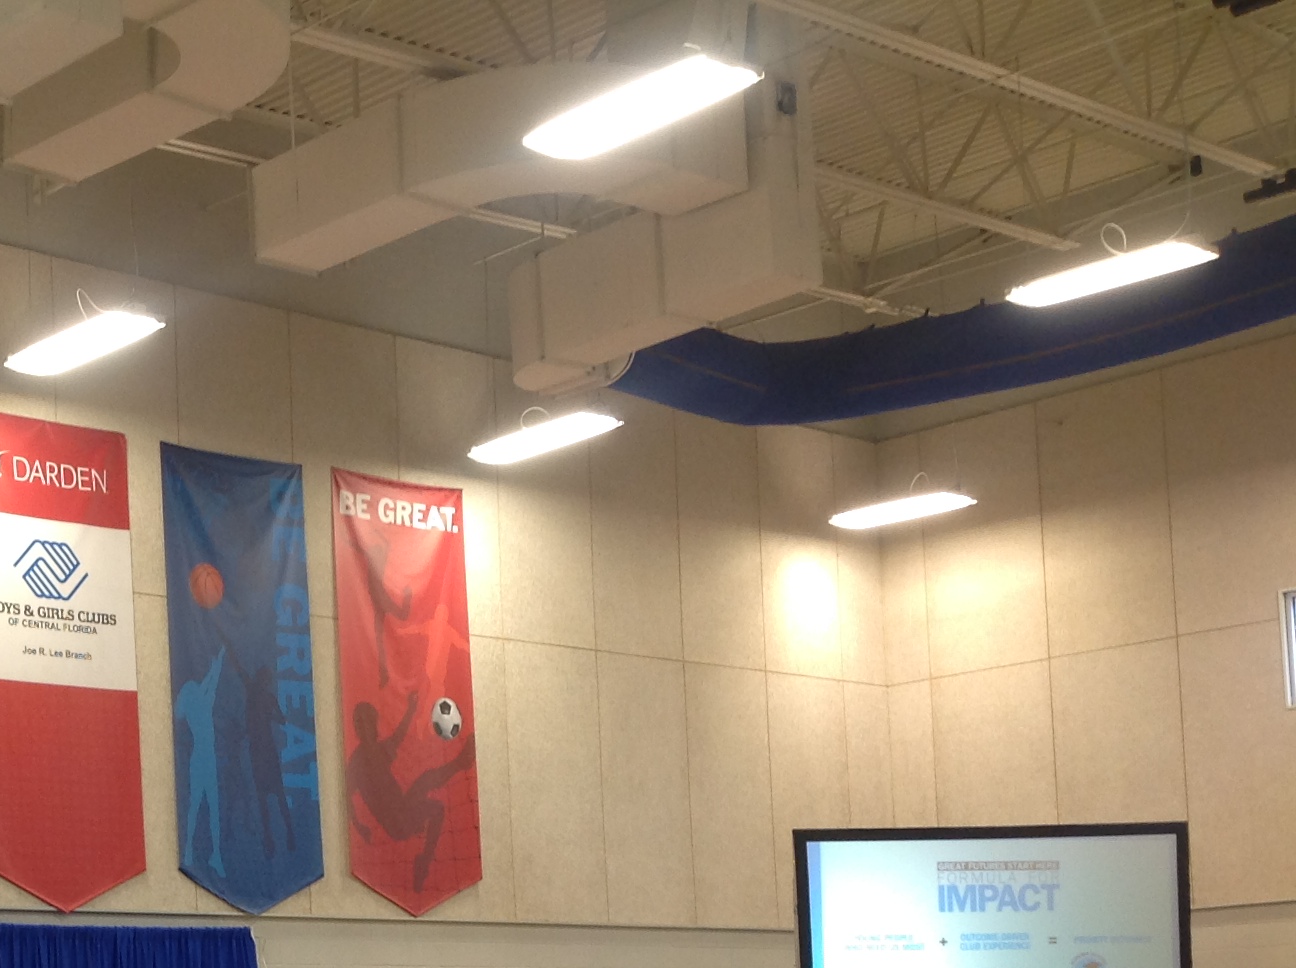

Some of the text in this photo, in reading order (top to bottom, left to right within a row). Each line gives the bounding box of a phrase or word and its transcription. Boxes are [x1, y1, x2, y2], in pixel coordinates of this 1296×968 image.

[12, 456, 108, 494] DARDEN
[269, 478, 304, 561] BE
[339, 489, 459, 533] BE GREAT.
[8, 617, 98, 635] OF CENTRAL FLORIDA
[24, 605, 34, 617] &
[37, 607, 75, 621] GIRLS
[78, 611, 117, 626] CLUBS
[23, 646, 93, 661] Joe R. Lee Branch
[938, 862, 966, 870] GREAT
[938, 884, 1061, 912] IMPACT
